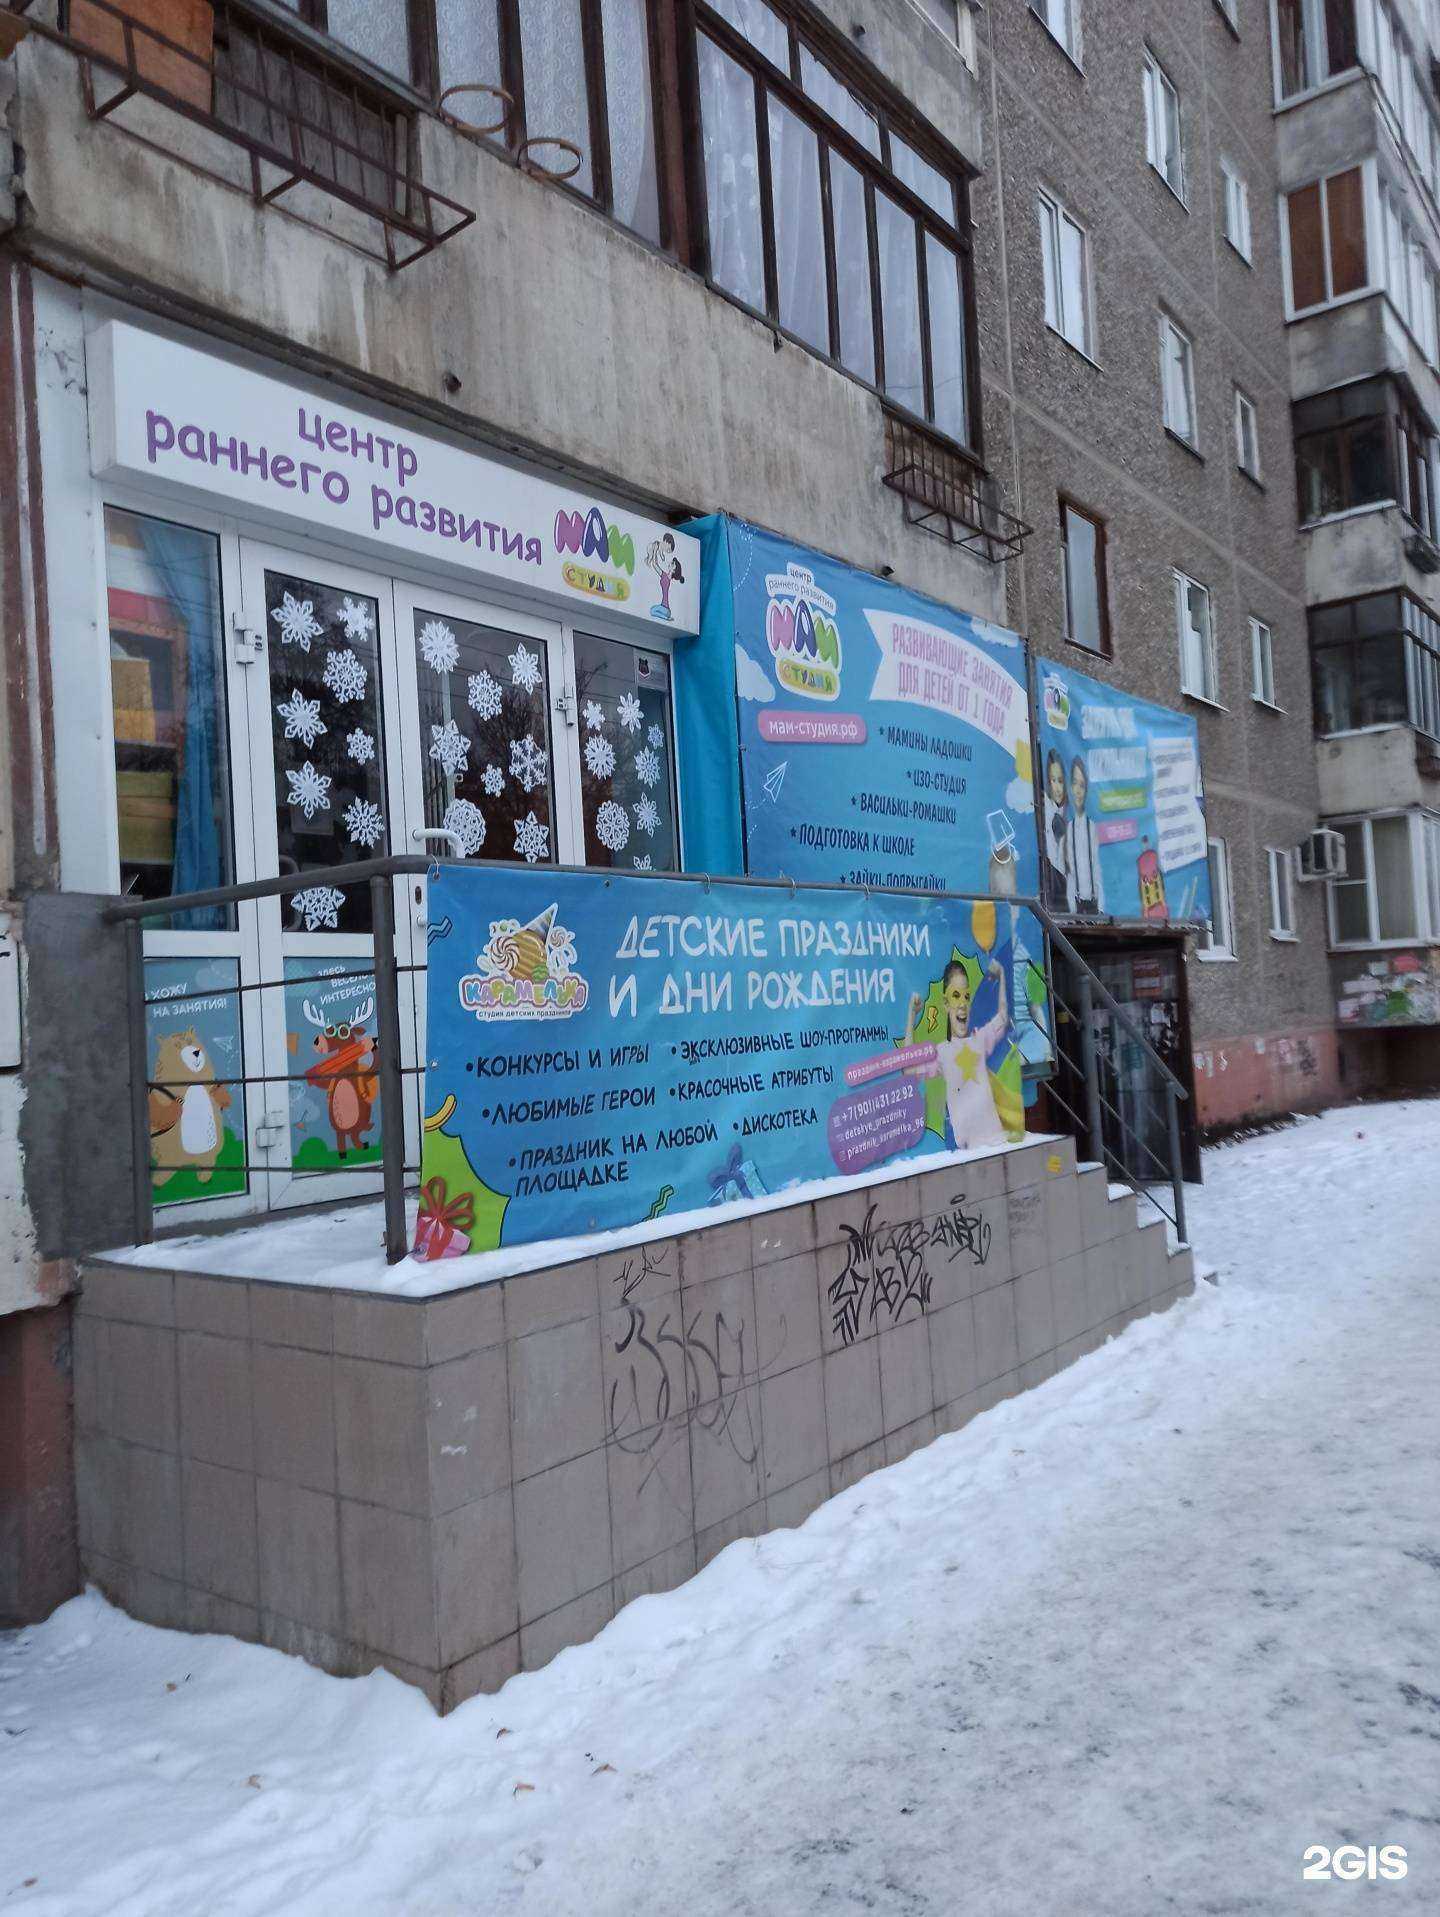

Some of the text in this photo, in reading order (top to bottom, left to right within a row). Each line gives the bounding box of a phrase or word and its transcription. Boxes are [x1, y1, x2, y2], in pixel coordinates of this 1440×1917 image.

[298, 408, 418, 487] центр
[146, 409, 542, 566] раннего развития
[553, 506, 635, 577] МАМ
[768, 580, 800, 593] раннего
[789, 568, 812, 584] центр
[770, 600, 839, 670] МАМ
[892, 622, 969, 678] РАЗВИВАЮЩИЕ
[971, 656, 1014, 710] ЗАНЯТИЯ
[898, 662, 920, 698] ДЛЯ
[923, 667, 955, 706] ДЕТЕЙ
[958, 683, 970, 713] ОТ
[973, 692, 979, 719] 1
[982, 699, 1005, 737] ГОДА
[769, 720, 858, 740] мам-студия.рф
[887, 726, 973, 762] МАМИНЫ ЛАДОШКИ
[913, 770, 967, 795] ИЗО-СТУДИЯ
[860, 792, 957, 824] ВАСИЛЬКИ-РОМАШКИ
[799, 823, 915, 857] ПОДГОТОВКА К ШКОЛЕ
[615, 915, 932, 959] ДЕТСКИЕ ПРАЗДНИКИ
[152, 982, 188, 1000] ХОЖУ
[152, 998, 228, 1018] НА ЗАНЯТИЯ!
[608, 967, 897, 1018] И ДНИ РОЖДЕНИЯ
[476, 1043, 649, 1078] КОНКУРСЫ И ИГРЫ
[680, 1025, 889, 1060] ЭКСКЛЮЗИВНЫЕ ШОУ-ПРОГРАММЫ
[677, 1065, 834, 1102] КРАСОЧНЫЕ АТРИБУТЫ
[491, 1086, 656, 1126] ЛЮБИМЫЕ ГЕРОИ
[741, 1107, 819, 1137] ДИСКОТЕКА
[520, 1118, 719, 1171] ПРАЗДНИК НА ЛЮБОЙ
[515, 1160, 630, 1198] ПЛОЩАДКЕ
